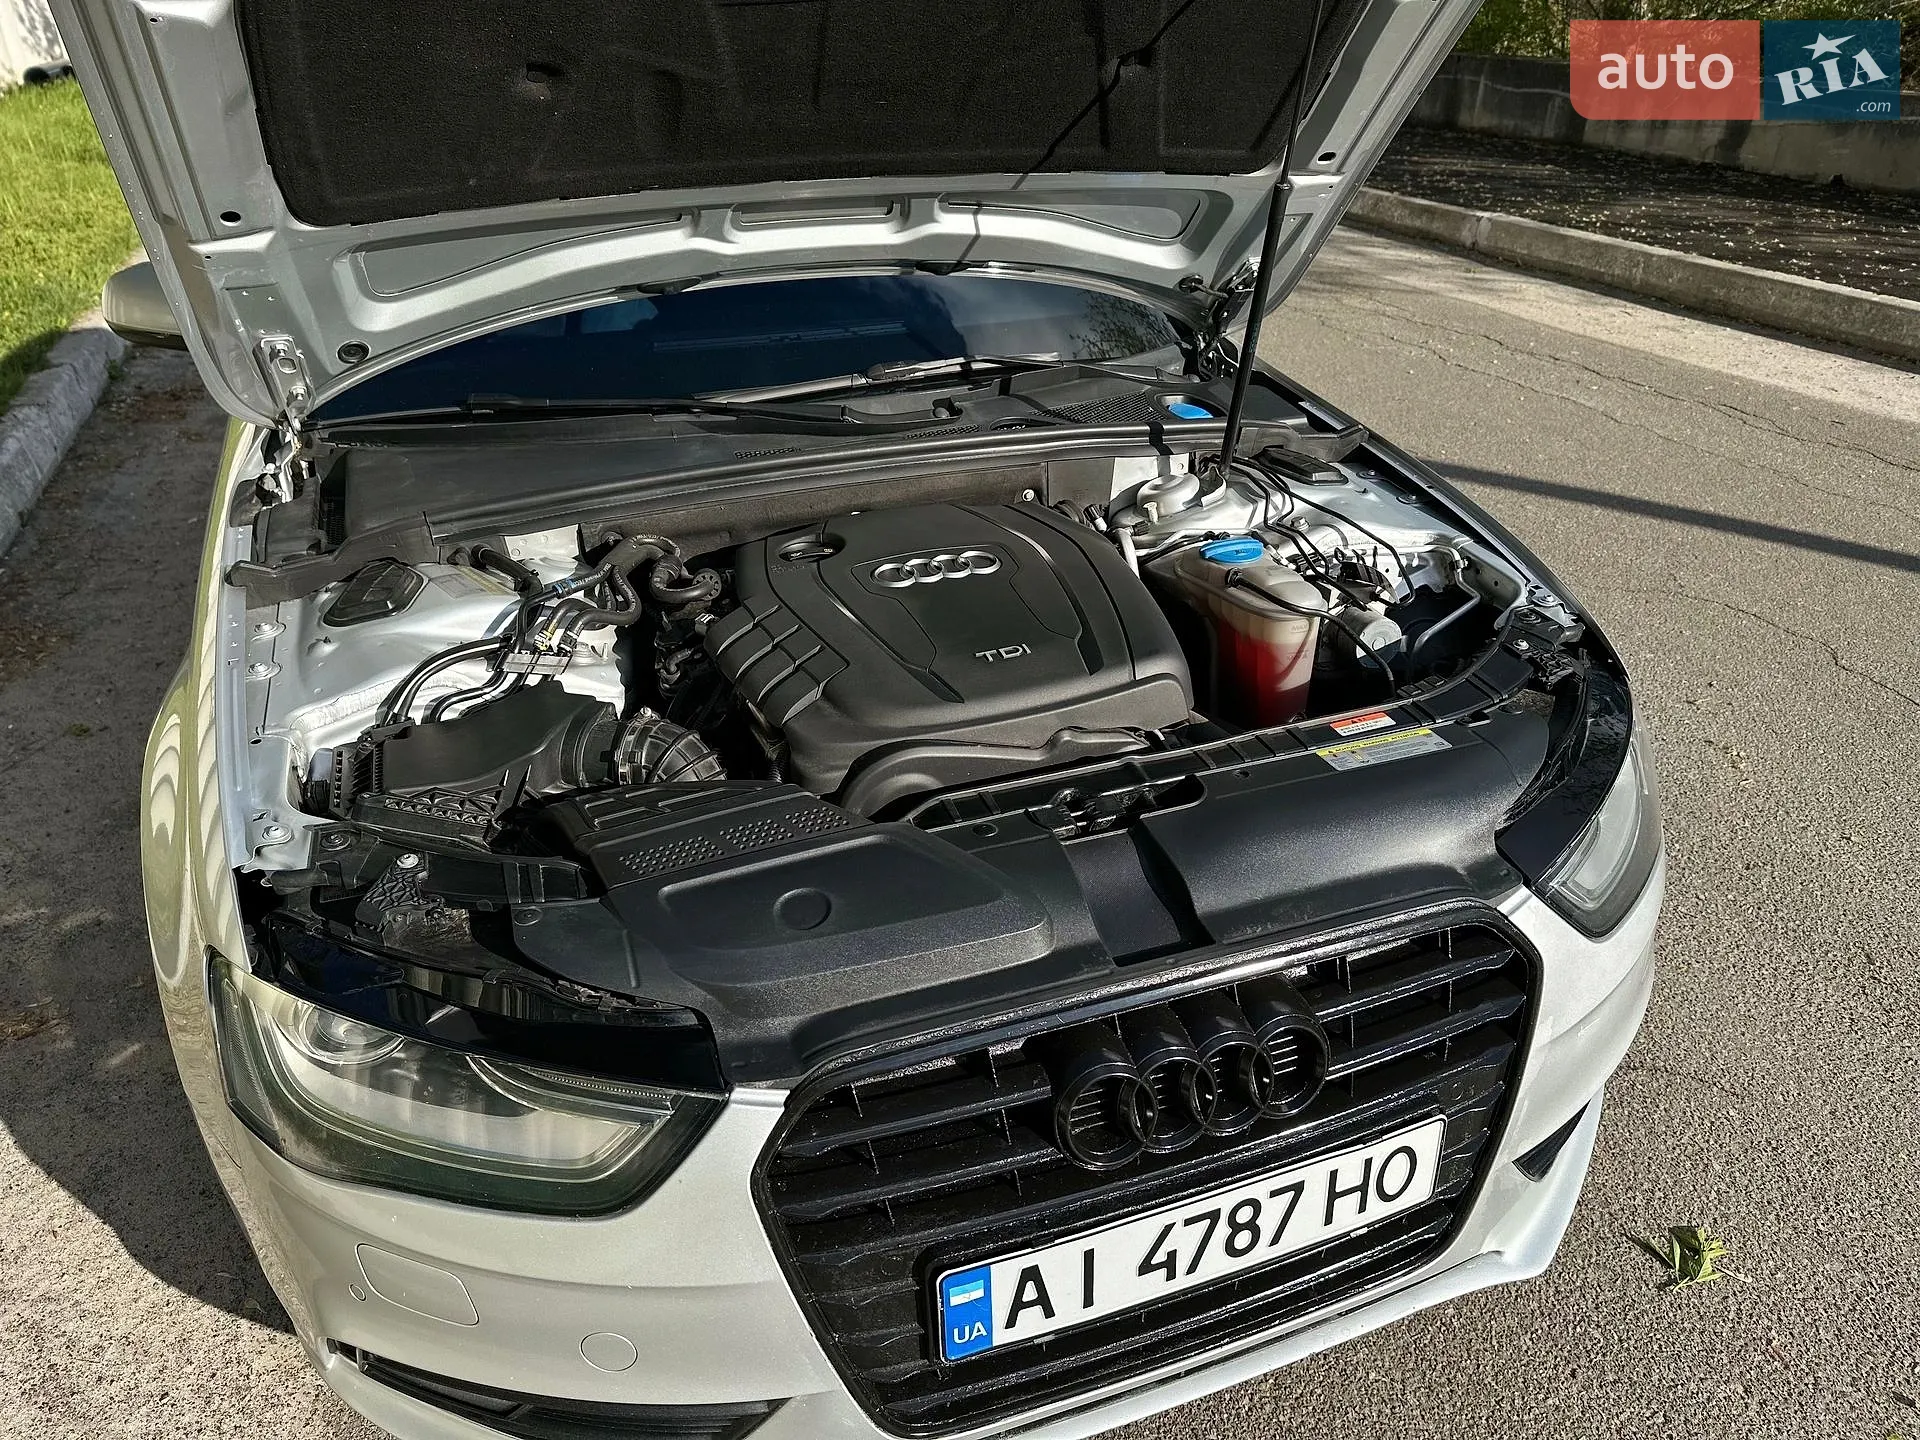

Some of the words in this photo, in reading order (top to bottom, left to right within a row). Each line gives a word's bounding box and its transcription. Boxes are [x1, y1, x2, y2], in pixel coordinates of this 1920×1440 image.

[975, 643, 1032, 662] TDI
[1004, 1247, 1095, 1329] AI
[1138, 1180, 1305, 1282] 4787
[1324, 1145, 1417, 1227] HO
[953, 1322, 987, 1345] UA
